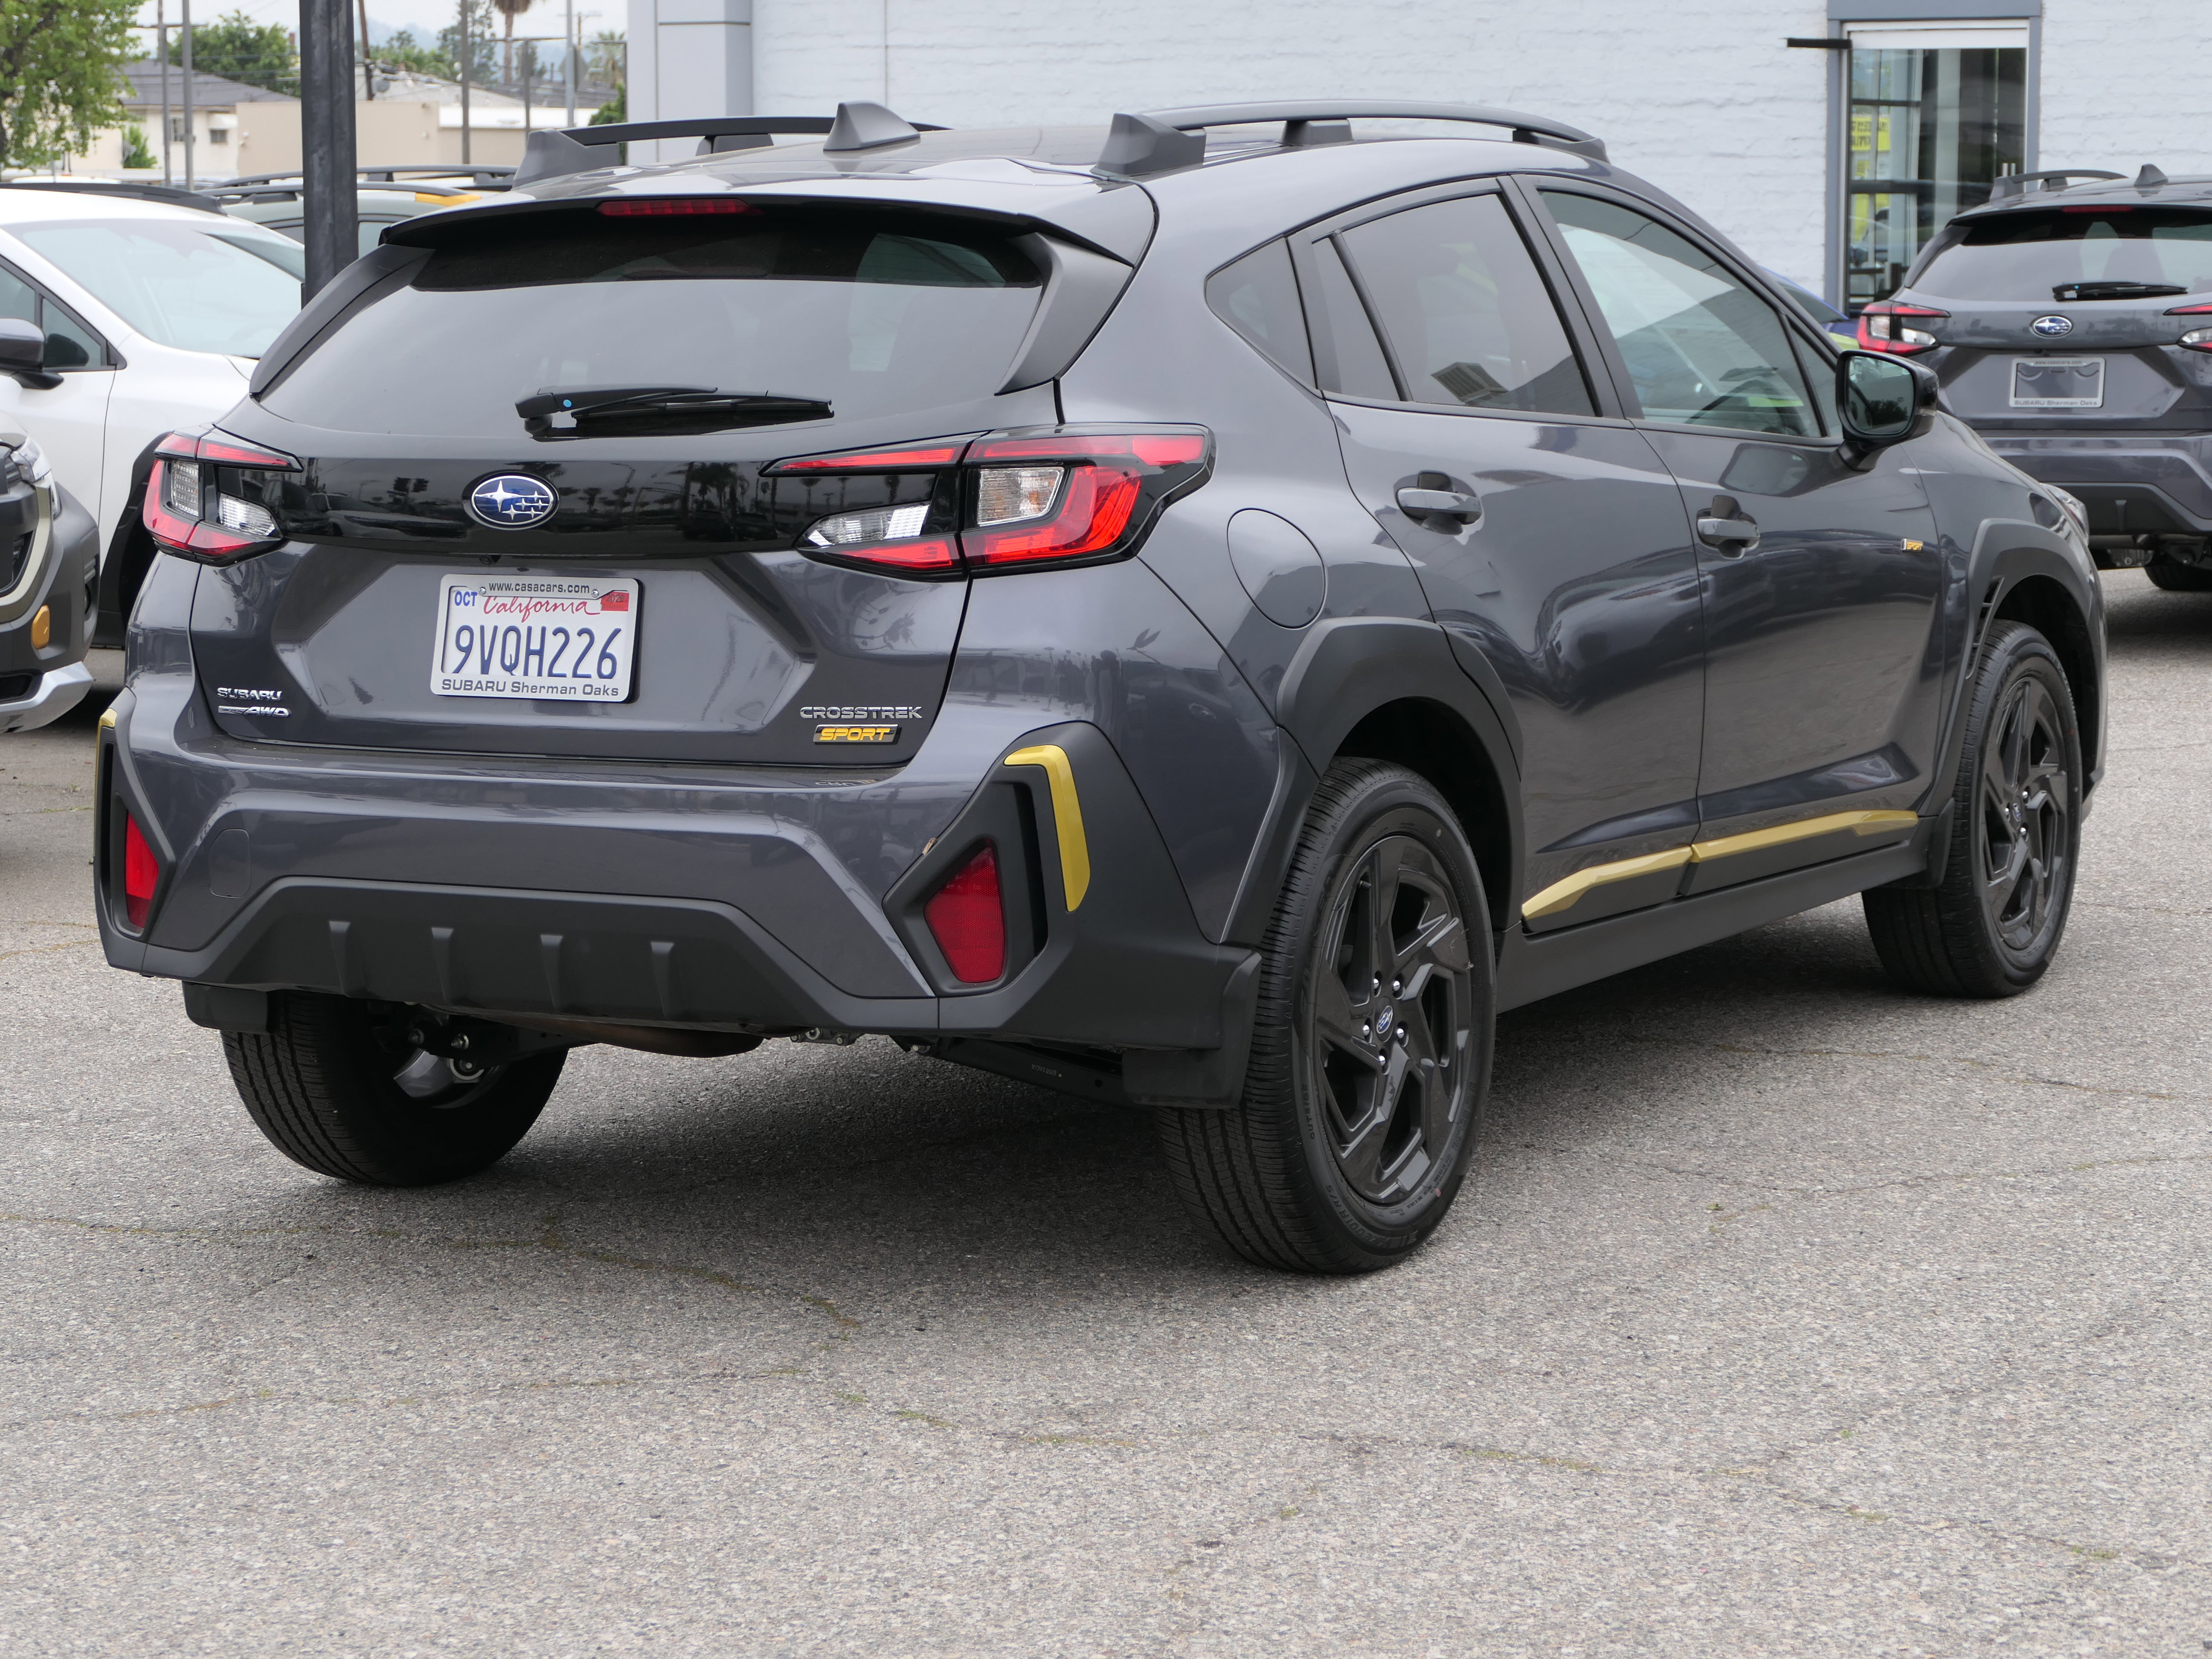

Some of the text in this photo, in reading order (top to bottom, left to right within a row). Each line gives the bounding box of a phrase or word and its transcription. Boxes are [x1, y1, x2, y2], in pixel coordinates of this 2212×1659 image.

[489, 582, 590, 594] www.casacars.com
[454, 591, 478, 607] OCT
[606, 593, 625, 603] 2026
[483, 596, 600, 623] California
[452, 625, 622, 679] 9VQH226
[217, 687, 282, 701] SUBARU
[442, 679, 619, 696] SUBARU Sherman Oaks
[246, 706, 290, 717] AWD
[800, 706, 923, 719] CROSSTREK
[819, 728, 890, 740] SPORT
